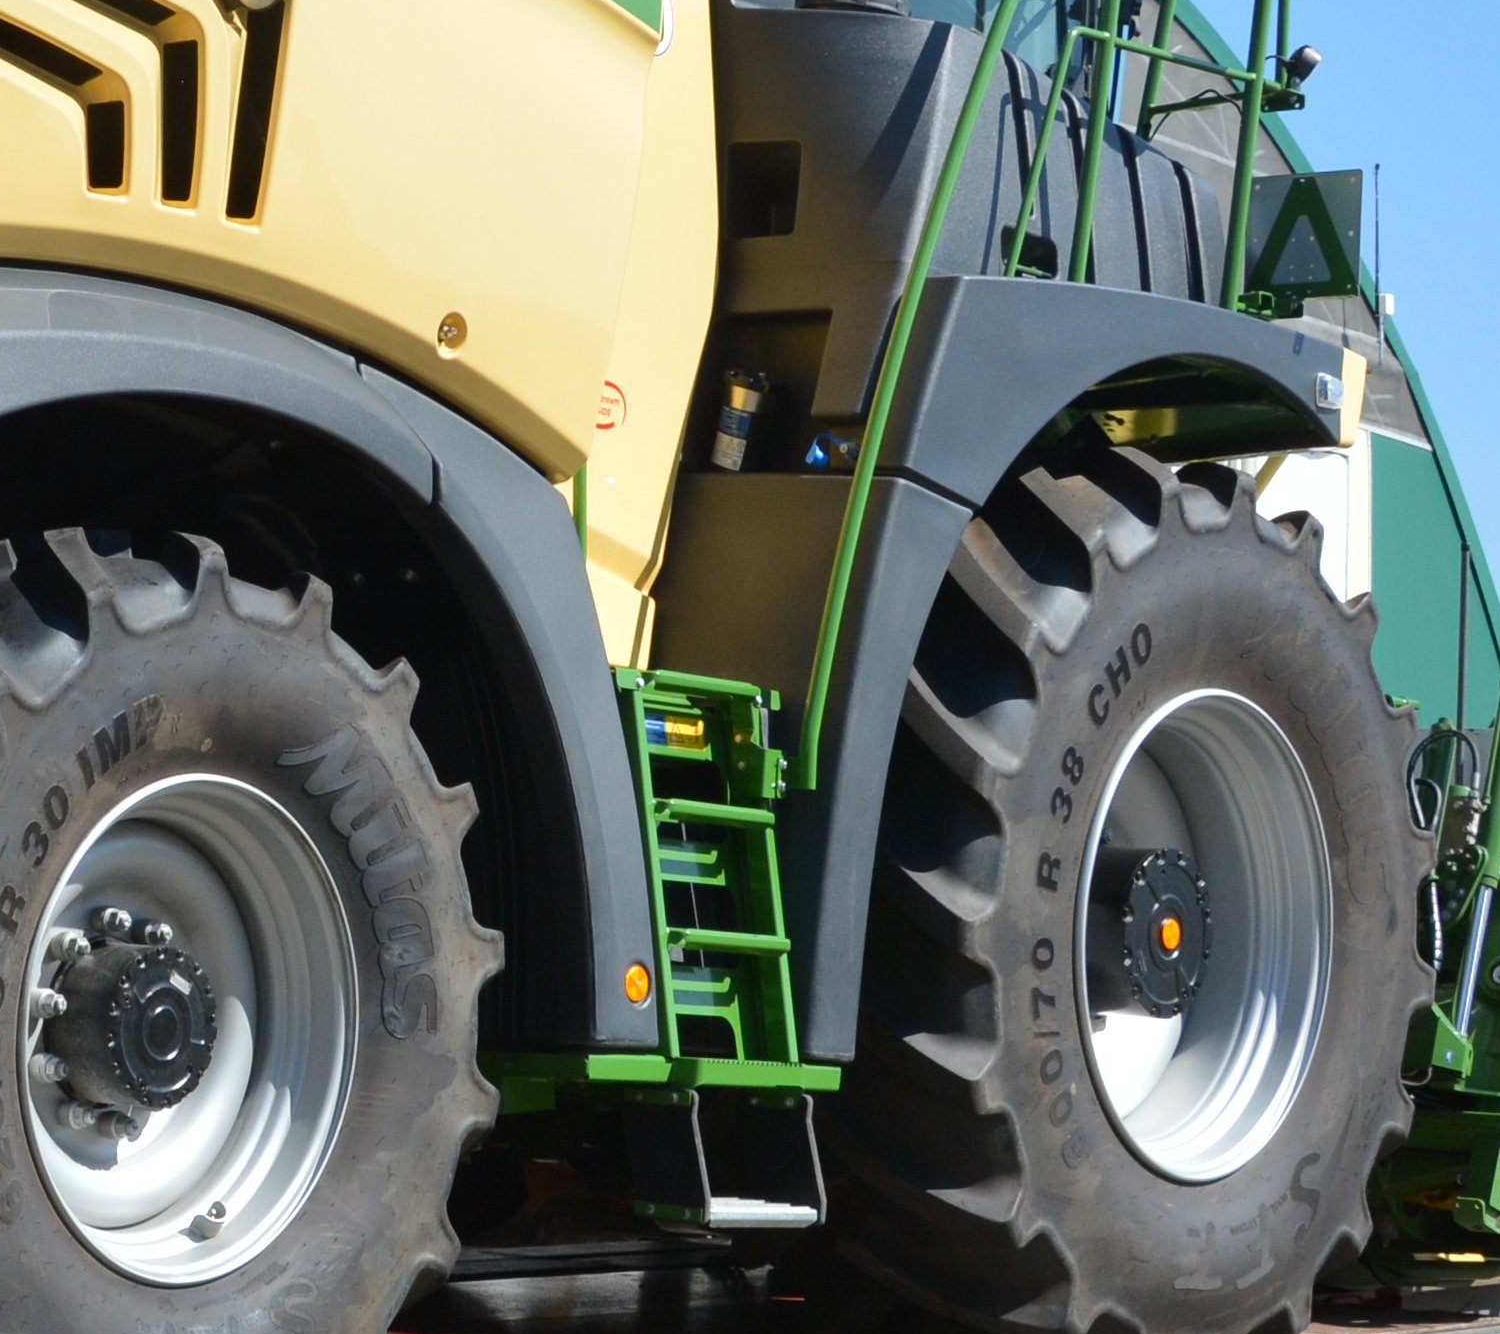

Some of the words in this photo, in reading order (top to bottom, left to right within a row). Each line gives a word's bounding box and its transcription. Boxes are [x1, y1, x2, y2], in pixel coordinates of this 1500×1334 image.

[22, 783, 70, 869] 30
[1038, 853, 1062, 892] R
[1050, 744, 1084, 825] 38
[1088, 622, 1154, 727] CHO
